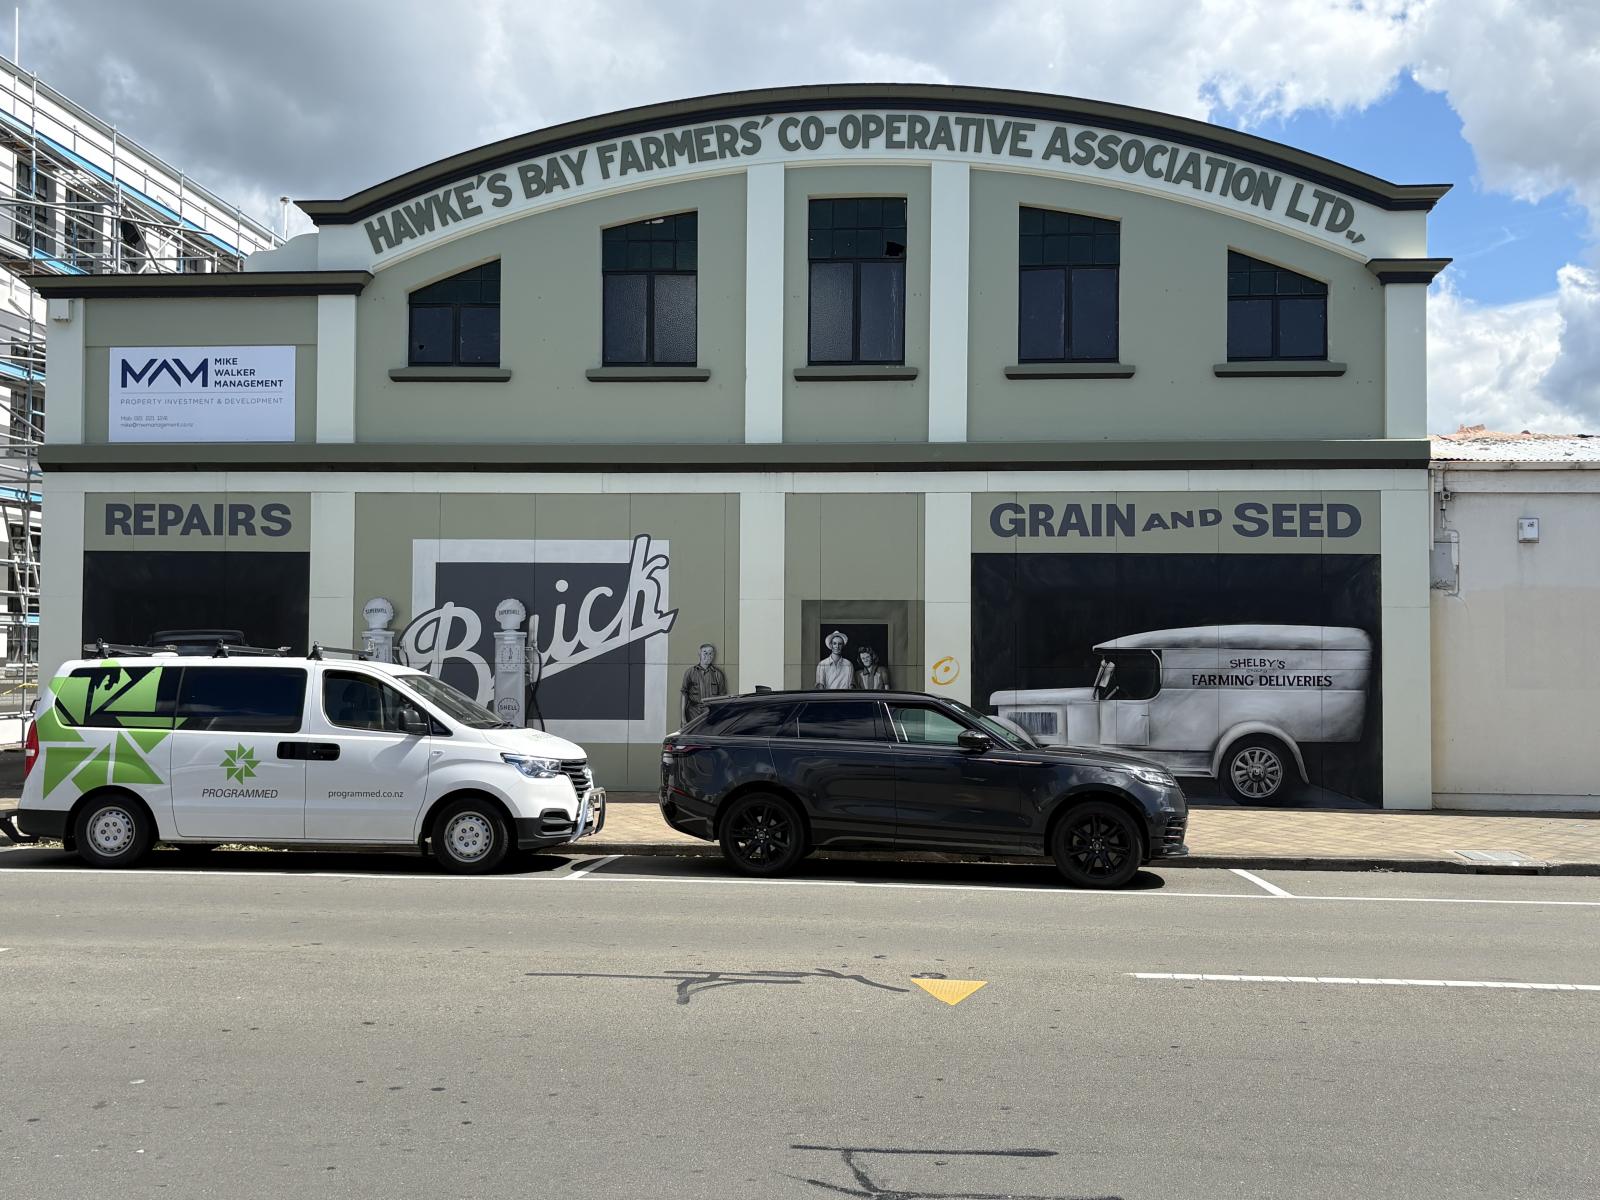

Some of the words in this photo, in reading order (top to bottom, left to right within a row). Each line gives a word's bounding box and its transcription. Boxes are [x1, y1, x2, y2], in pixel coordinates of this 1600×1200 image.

[364, 173, 513, 254] HAWKE'S
[517, 149, 588, 200] BAY
[597, 116, 774, 180] FARMERS'
[778, 114, 1036, 158] CO-OPERATIVE
[1041, 126, 1282, 211] ASSOCIATION
[214, 357, 238, 366] MIKE
[214, 368, 256, 377] WALKER
[214, 379, 284, 388] MANAGEMENT
[224, 397, 283, 405] DEVELOPMENT
[105, 503, 292, 537] REPAIRS
[989, 502, 1136, 538] GRAIN
[1141, 508, 1223, 532] AND
[1232, 502, 1362, 538] SEED
[1229, 658, 1286, 670] SHELBY'S
[1192, 674, 1253, 687] FARMING
[1259, 675, 1333, 687] DELIVERIES
[201, 788, 279, 799] PROGRAMMED
[328, 789, 404, 799] programmed.co.nz
